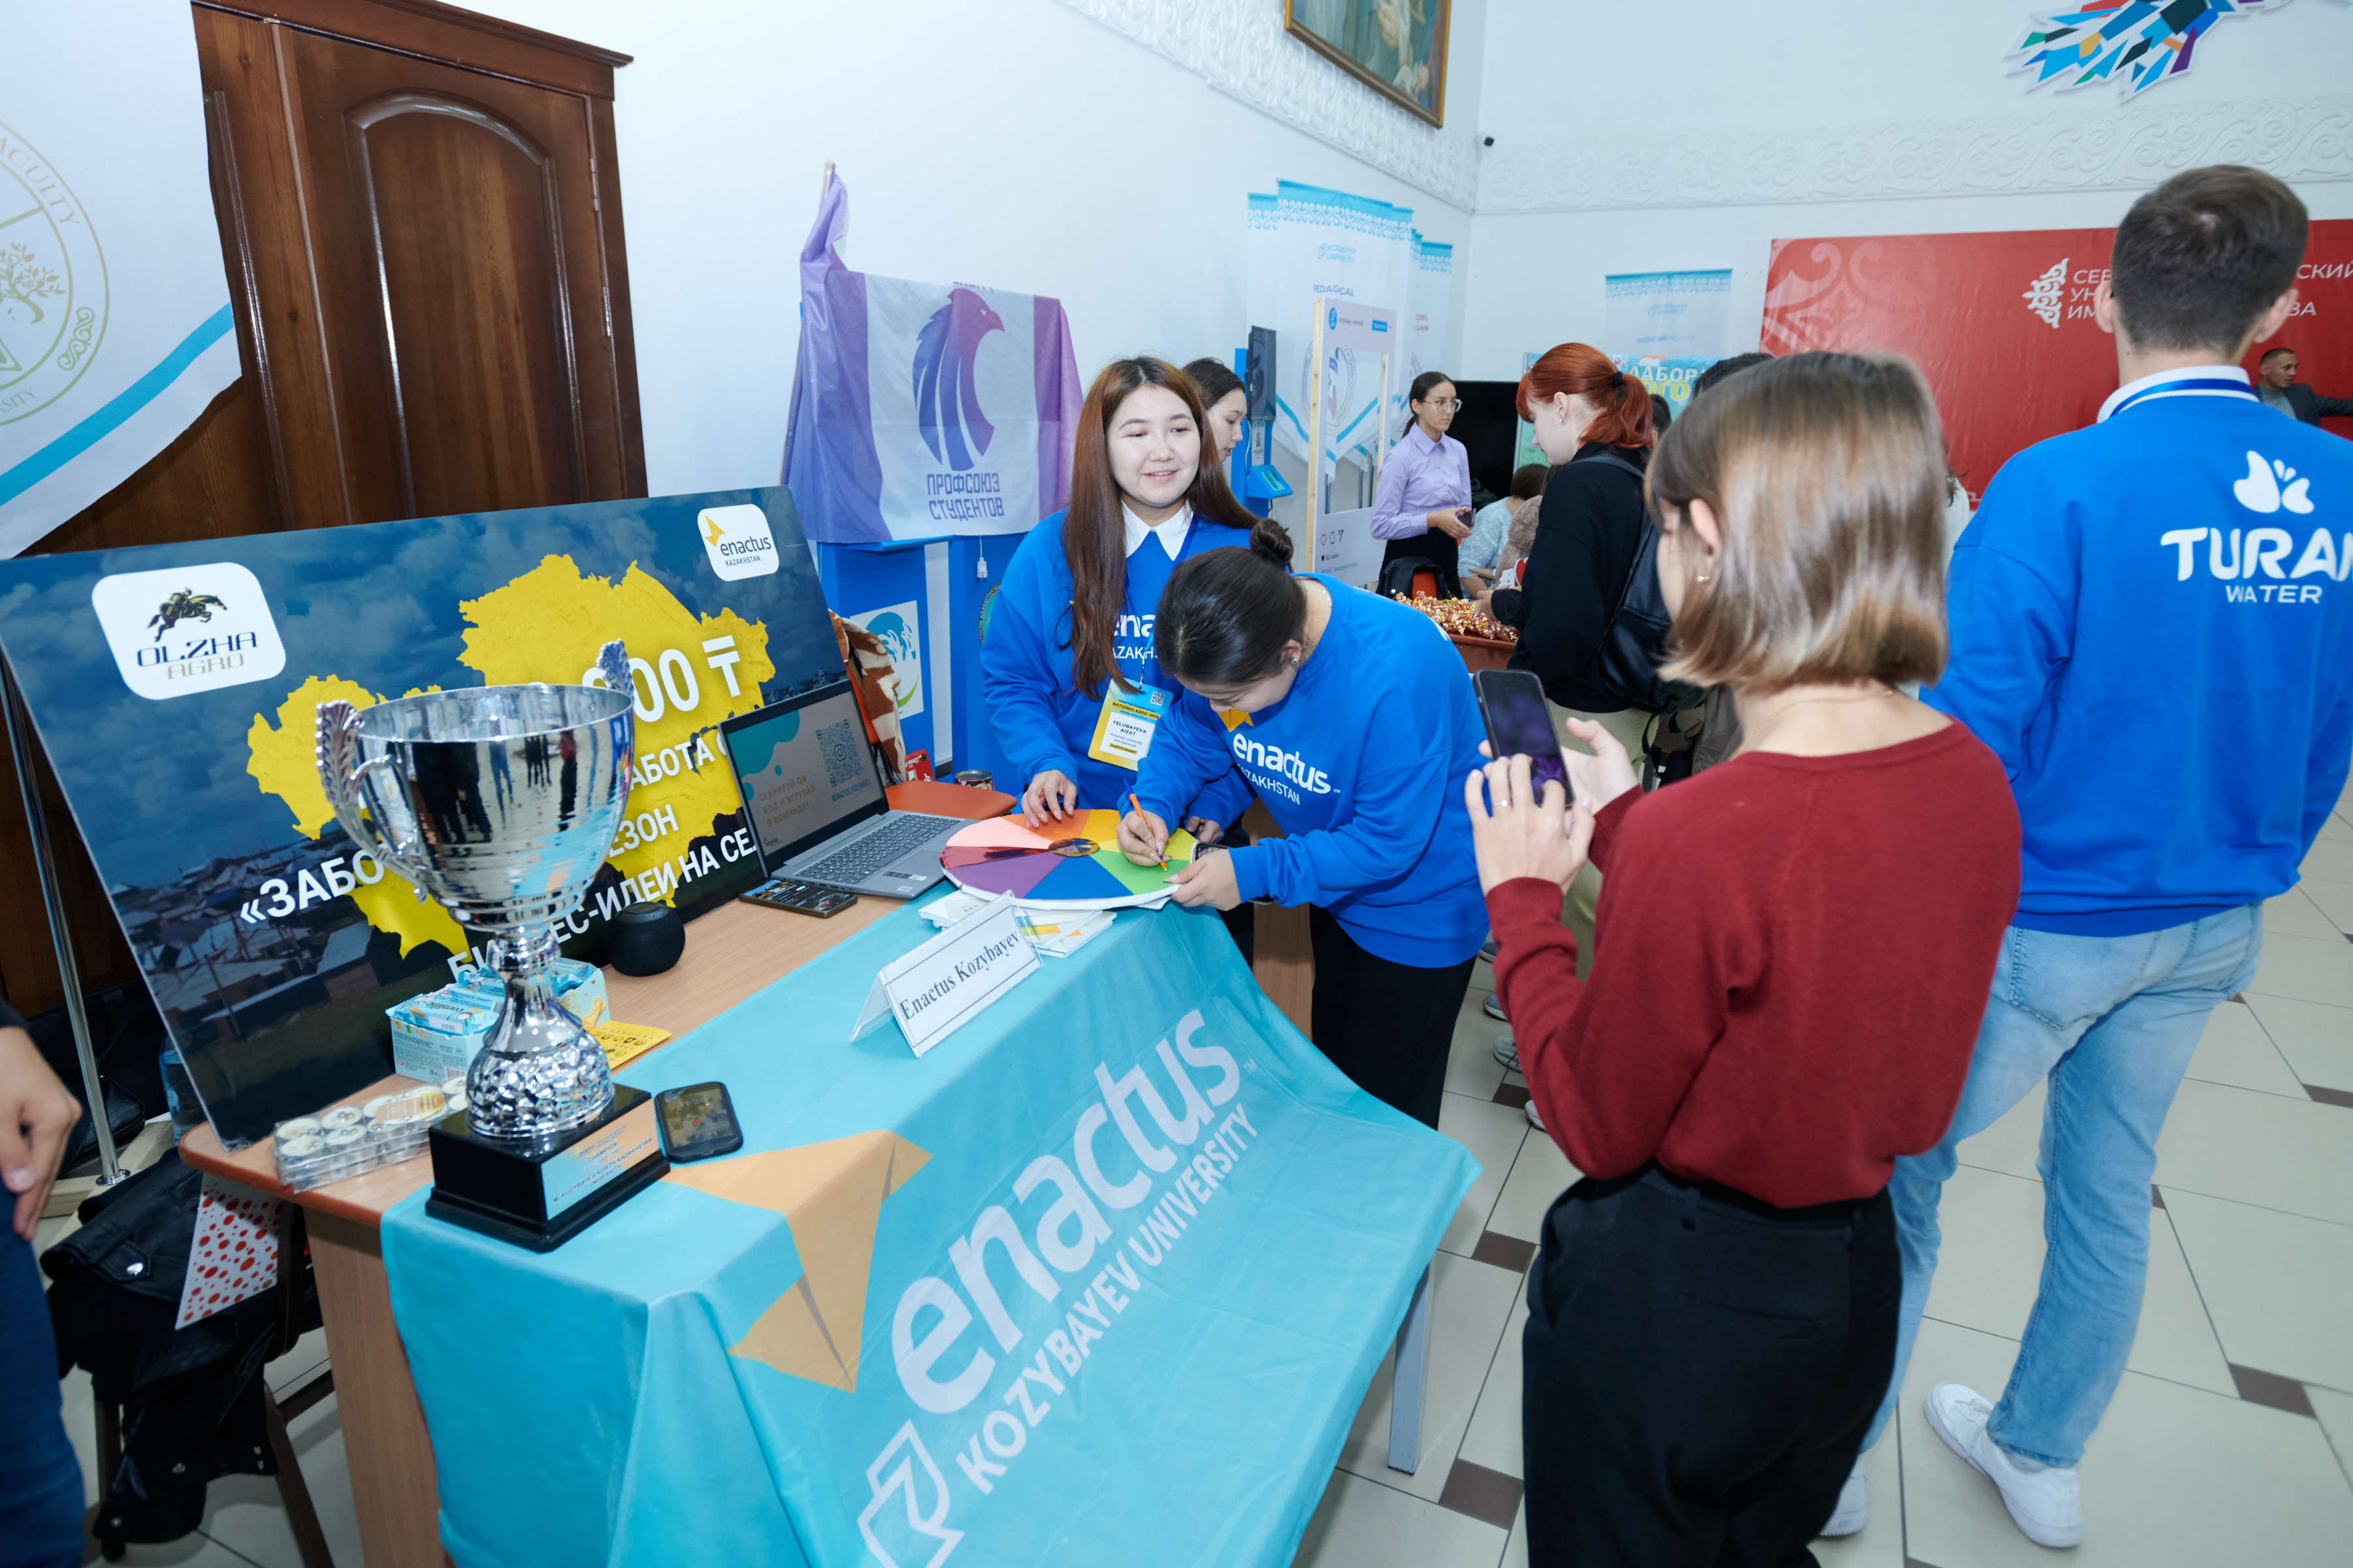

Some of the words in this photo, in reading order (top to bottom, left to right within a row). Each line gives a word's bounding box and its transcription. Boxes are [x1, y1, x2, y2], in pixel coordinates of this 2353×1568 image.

[1630, 364, 1705, 383] ЛАБОР
[926, 472, 1001, 496] ПРОФСОЮЗ
[929, 496, 1005, 521] СТУДЕНТОВ
[720, 536, 772, 556] enactus
[725, 555, 762, 567] KAZAKHSTAN
[2225, 584, 2324, 604] WATER
[136, 631, 259, 667] OLZHA
[167, 653, 244, 680] AGRO
[1112, 701, 1135, 712] NATIONAL
[1112, 720, 1146, 734] YELUBAYEVA
[1110, 743, 1137, 754] PARTICIPANT
[1233, 733, 1331, 794] enactus
[796, 775, 807, 785] QR
[1238, 763, 1301, 805] AZAKHSTAN
[763, 801, 779, 814] КОД
[786, 784, 817, 805] ВСТУПАЙ
[773, 801, 809, 824] КОМАНДУ!
[677, 844, 721, 883] НА
[720, 827, 756, 863] СЕ
[240, 844, 387, 925] «ЗАБО
[899, 974, 956, 1021] Enactus
[952, 929, 1020, 984] Kozybayev
[588, 1142, 617, 1163] CHAMPION
[596, 1159, 617, 1175] NORTH
[616, 1137, 653, 1163] KAZAKHSTAN
[589, 1164, 621, 1188] UNIVERSITY
[891, 1009, 1241, 1414] enactus
[955, 1250, 1143, 1495] KOZYBAYEV
[1127, 1103, 1258, 1268] UNIVERSITY
